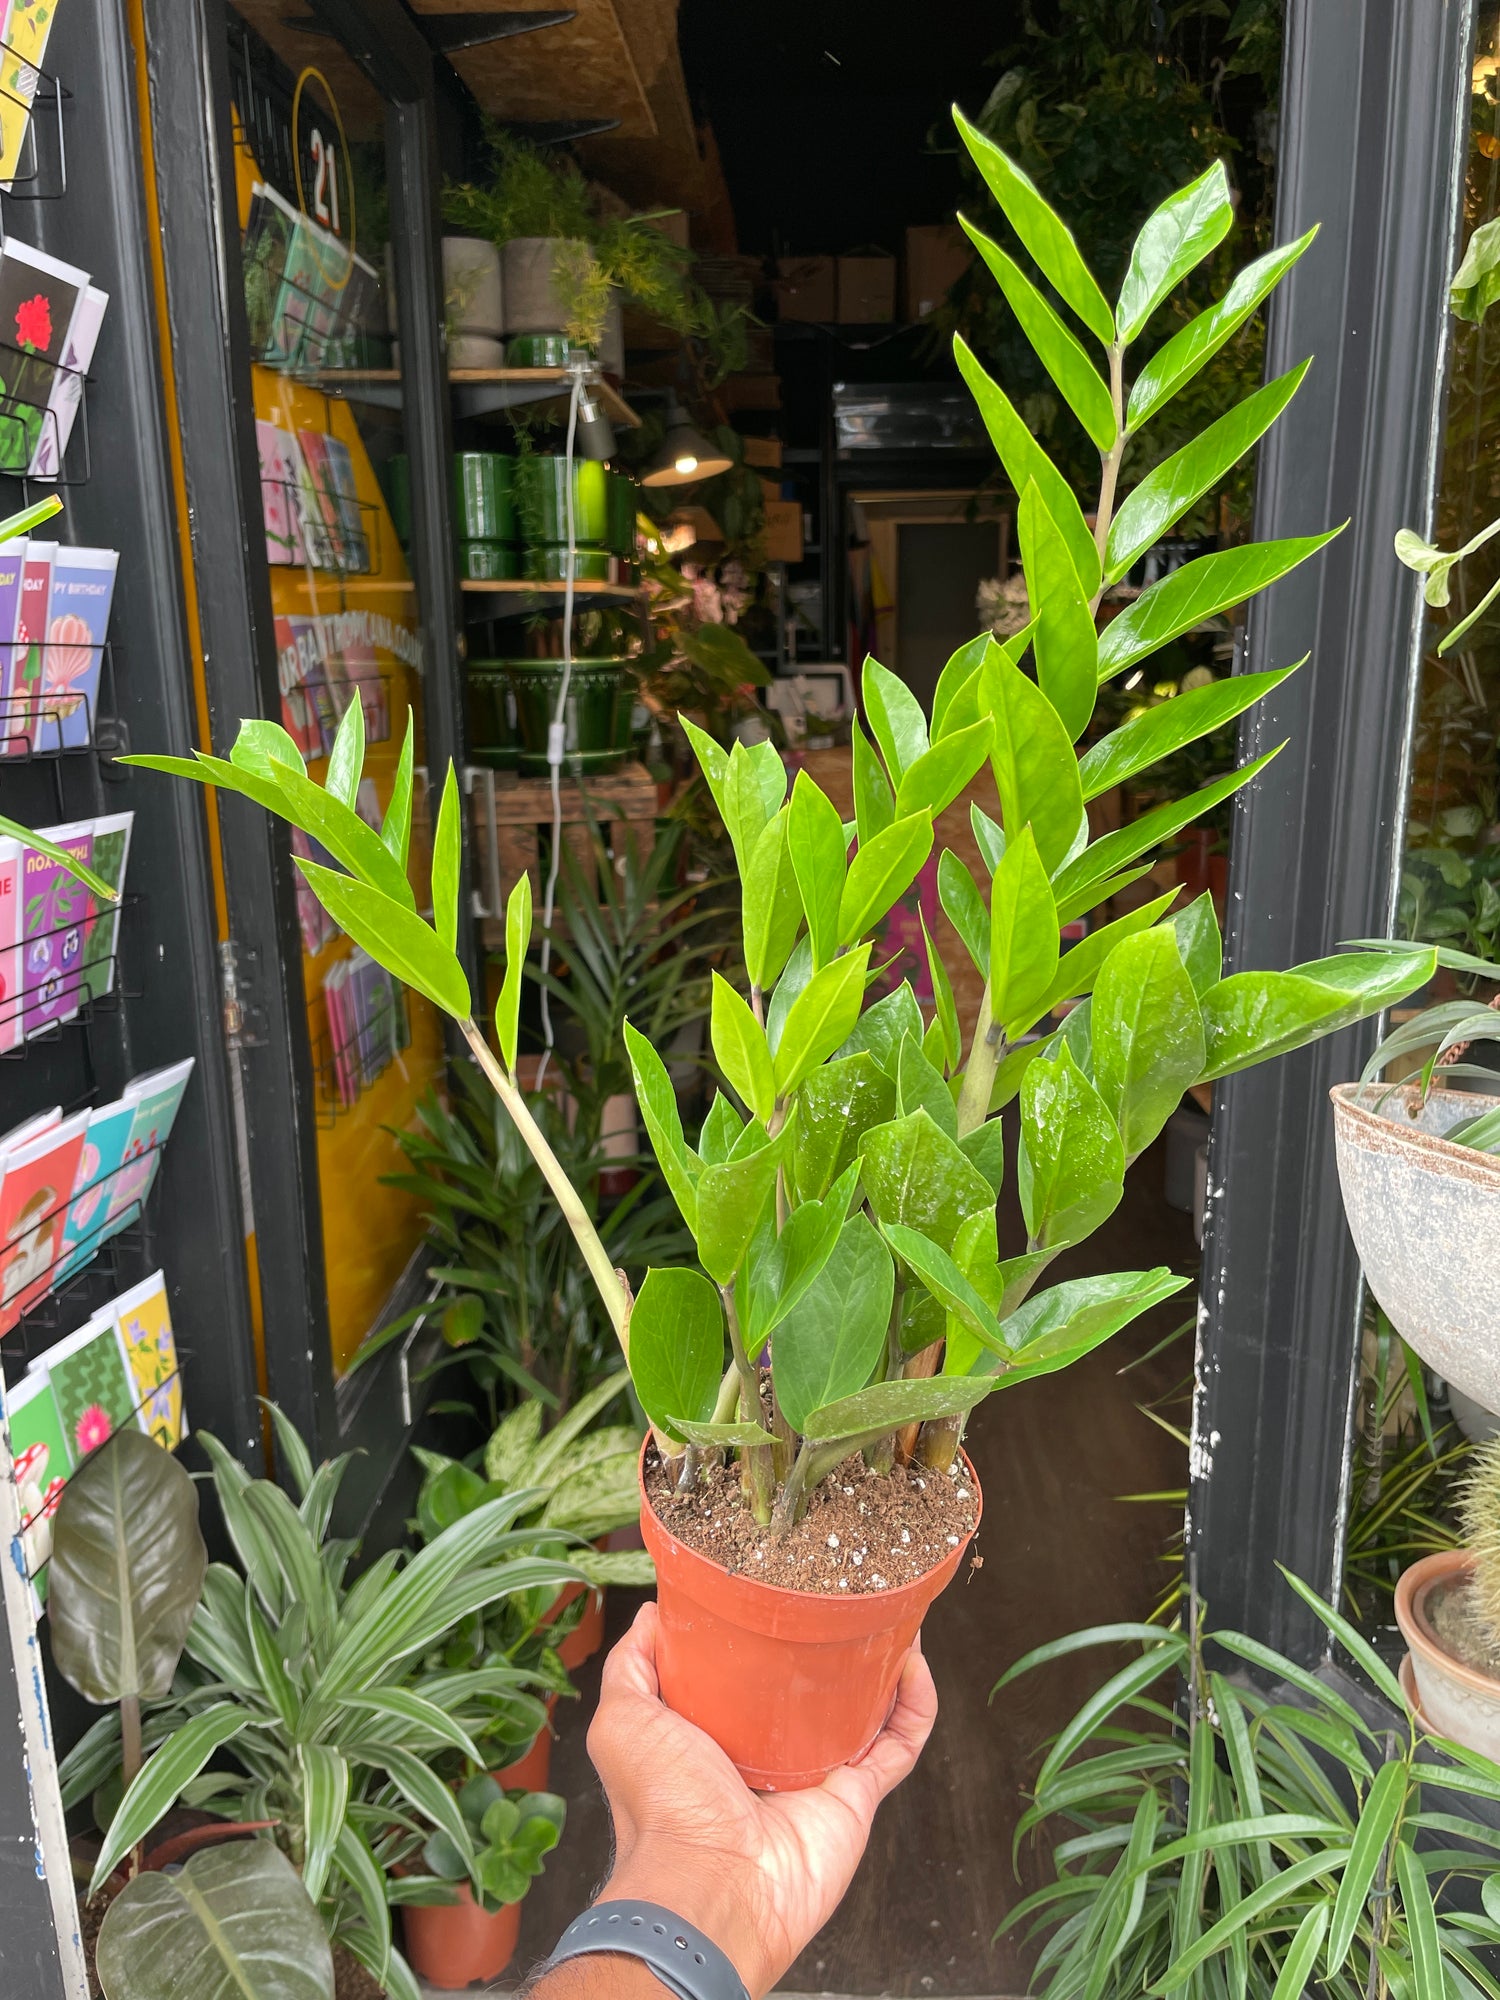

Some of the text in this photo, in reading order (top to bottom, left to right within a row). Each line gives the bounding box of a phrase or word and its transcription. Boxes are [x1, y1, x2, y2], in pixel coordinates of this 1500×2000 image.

[311, 128, 341, 236] 21
[68, 583, 107, 596] BIRTHDAY
[27, 855, 52, 874] YOU
